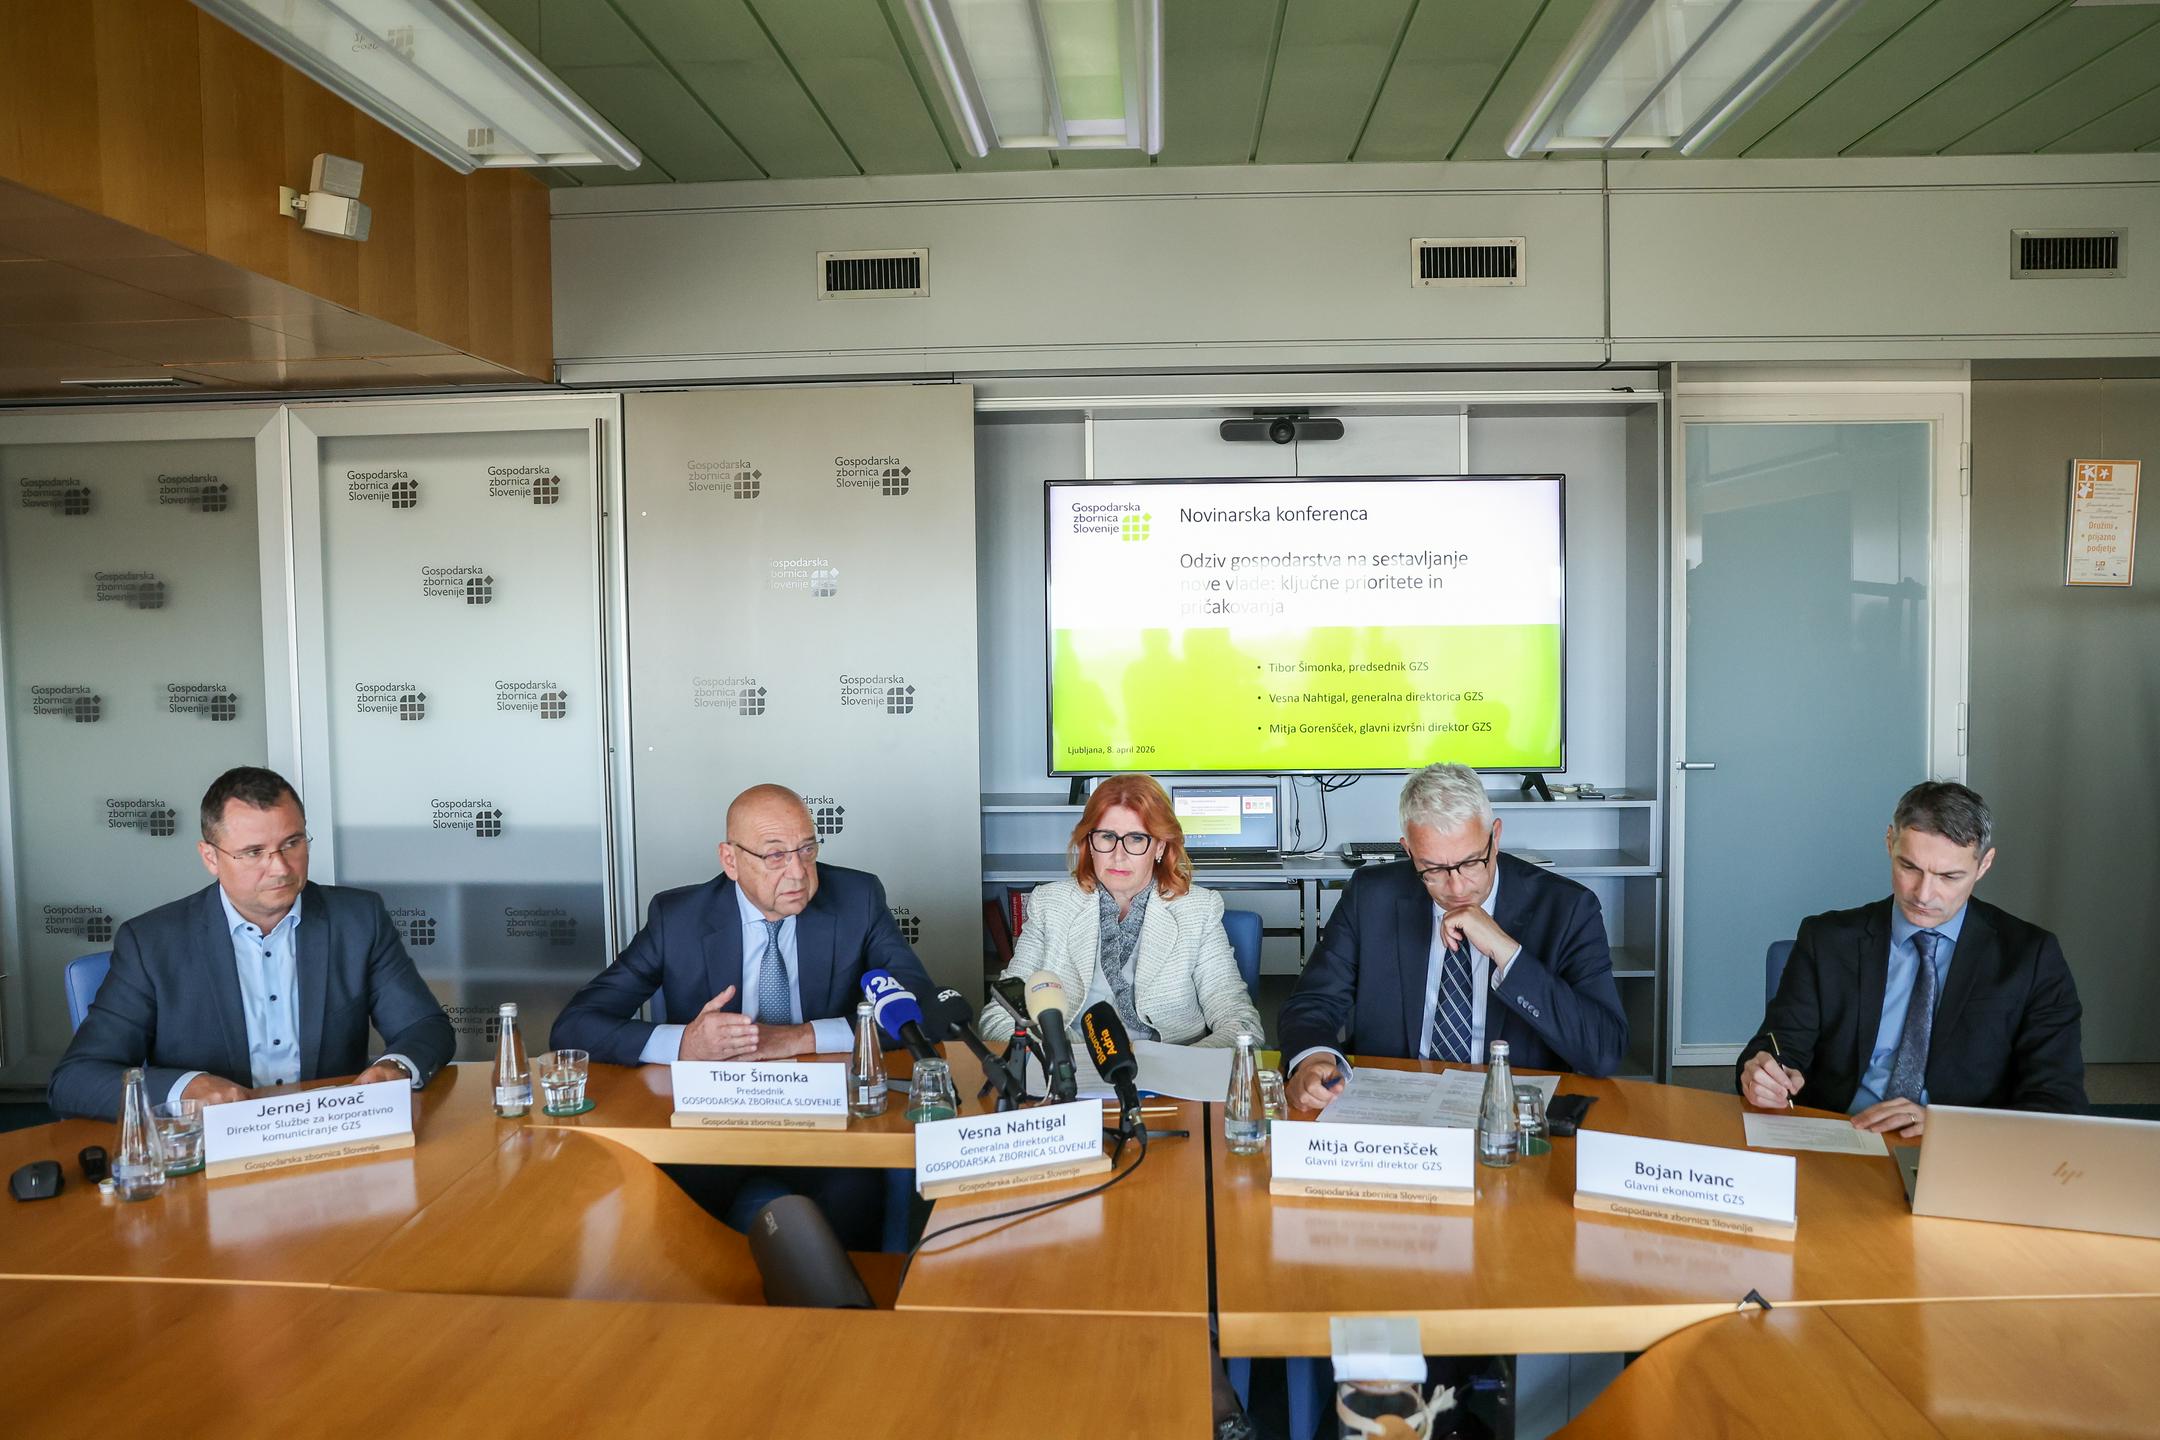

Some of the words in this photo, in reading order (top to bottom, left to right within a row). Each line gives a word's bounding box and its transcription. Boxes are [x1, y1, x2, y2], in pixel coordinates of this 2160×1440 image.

[687, 459, 751, 470] Gospodarska
[834, 456, 900, 467] Gospodarska
[347, 469, 408, 480] Gospodarska
[488, 465, 550, 476] Gospodarska
[689, 470, 731, 480] zbornica
[836, 467, 879, 477] zbornica
[20, 478, 80, 488] Gospodarska
[158, 474, 218, 485] Gospodarska
[348, 480, 388, 490] zbornica
[489, 476, 530, 486] zbornica
[836, 478, 880, 489] Slovenije
[489, 486, 531, 498] Slovenije
[689, 481, 732, 492] Slovenije
[348, 490, 390, 502] Slovenije
[1072, 502, 1140, 514] Gospodarska
[1180, 506, 1271, 523] Novinarska
[1276, 504, 1368, 522] konferenca
[1074, 514, 1118, 522] zbornica
[1073, 523, 1120, 535] Slovenije
[1180, 552, 1226, 568] Odziv
[1230, 552, 1341, 572] gospodarstva
[1347, 554, 1367, 567] na
[1372, 550, 1468, 570] sestavljanje
[422, 565, 483, 576] Gospodarska
[424, 576, 464, 586] zbornica
[1281, 574, 1340, 593] ključne
[1345, 574, 1423, 593] prioritete
[1428, 574, 1443, 589] in
[424, 586, 464, 598] Slovenije
[1268, 662, 1296, 672] Tibor
[1298, 660, 1346, 673] Šimonka,
[1348, 662, 1406, 674] predsednik
[1409, 662, 1429, 672] GZS
[495, 680, 557, 691] Gospodarska
[692, 676, 756, 687] Gospodarska
[839, 674, 904, 686] Gospodarska
[32, 686, 91, 696] Gospodarska
[167, 684, 227, 694] Gospodarska
[355, 682, 416, 694] Gospodarska
[694, 687, 736, 697] zbornica
[841, 686, 884, 695] zbornica
[33, 696, 73, 705] zbornica
[168, 694, 208, 703] zbornica
[357, 693, 397, 702] zbornica
[496, 690, 537, 700] zbornica
[1269, 694, 1300, 703] Vesna
[1302, 692, 1348, 704] Nahtigal,
[1351, 692, 1403, 704] generalna
[1405, 692, 1461, 702] direktorica
[1464, 692, 1484, 701] GZS
[496, 701, 538, 712] Slovenije
[694, 698, 737, 708] Slovenije
[841, 696, 885, 708] Slovenije
[33, 706, 74, 716] Slovenije
[169, 704, 209, 714] Slovenije
[357, 703, 398, 714] Slovenije
[1269, 724, 1297, 735] Mitja
[1299, 722, 1357, 734] Gorenšček,
[1360, 722, 1390, 735] glavni
[1392, 722, 1425, 733] izvršni
[1428, 721, 1470, 732] direktor
[1472, 722, 1492, 732] GZS
[1068, 746, 1105, 756] Ljubljana,
[1107, 746, 1115, 754] 8.
[1116, 746, 1134, 754] april
[1136, 746, 1156, 754] 2026
[106, 798, 166, 810] Gospodarska
[430, 798, 492, 809] Gospodarska
[108, 809, 148, 818] zbornica
[432, 808, 473, 818] zbornica
[108, 818, 149, 830] Slovenije
[432, 819, 474, 830] Slovenije
[44, 905, 103, 916] Gospodarska
[504, 906, 566, 918] Gospodarska
[44, 915, 84, 924] zbornica
[45, 925, 86, 936] Slovenije
[710, 1070, 746, 1082] Tibor
[751, 1068, 808, 1083] Šimonka
[736, 1086, 784, 1096] Predsednik
[257, 1099, 311, 1118] Jernej
[318, 1091, 366, 1109] Kovač
[682, 1097, 746, 1106] GOSPODARSKA
[748, 1098, 793, 1106] ZBORNICA
[794, 1098, 842, 1106] SLOVENIJE
[226, 1122, 271, 1136] Direktor
[275, 1116, 310, 1129] Službe
[313, 1116, 324, 1124] za
[328, 1106, 394, 1124] korporativno
[702, 1118, 750, 1127] Gospodarska
[262, 1124, 338, 1142] komuniciranje
[341, 1120, 362, 1131] GZS
[958, 1126, 1001, 1141] Vesna
[1007, 1114, 1066, 1134] Nahtigal
[960, 1142, 1010, 1156] Generalna
[1012, 1133, 1064, 1148] direktorica
[1308, 1139, 1348, 1155] Mitja
[1354, 1140, 1438, 1156] Gorenšček
[244, 1155, 302, 1171] Gospodarska
[304, 1150, 341, 1161] zbornica
[926, 1156, 996, 1174] GOSPODARSKA
[999, 1149, 1046, 1162] ZBORNICA
[1048, 1140, 1097, 1156] SLOVENIJE
[1304, 1156, 1338, 1166] Glavni
[1340, 1157, 1374, 1168] izvršni
[1376, 1160, 1418, 1170] direktor
[1422, 1162, 1442, 1171] GZS
[1635, 1161, 1683, 1181] Bojan
[1690, 1169, 1734, 1188] Ivanc
[1304, 1186, 1360, 1198] Gospodarska
[1624, 1179, 1659, 1193] Glavni
[1662, 1186, 1719, 1202] ekonomist
[1722, 1194, 1745, 1206] GZS
[1610, 1202, 1669, 1220] Gospodarska
